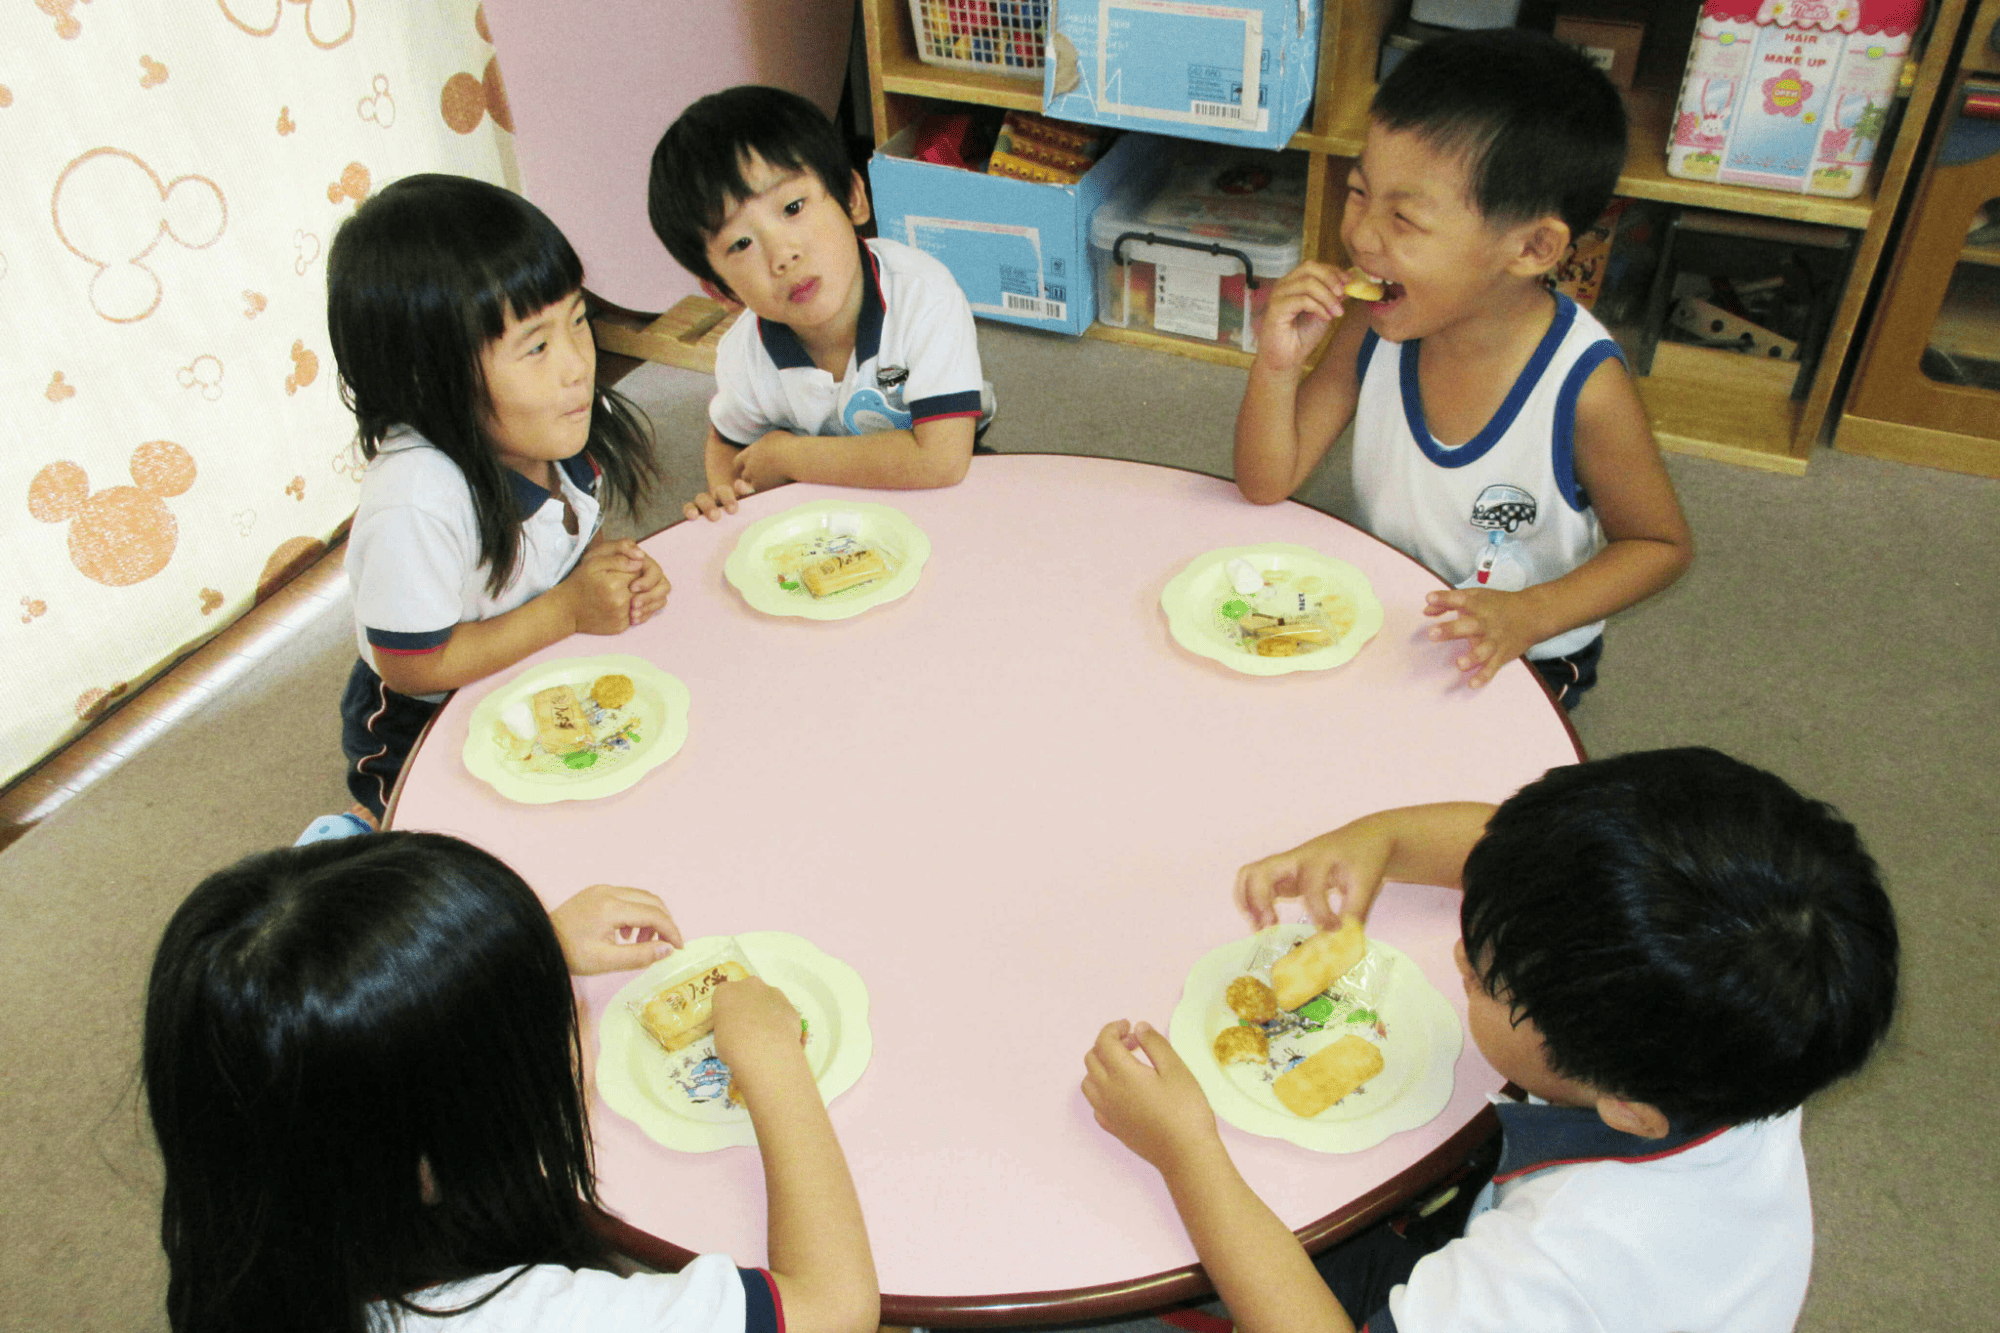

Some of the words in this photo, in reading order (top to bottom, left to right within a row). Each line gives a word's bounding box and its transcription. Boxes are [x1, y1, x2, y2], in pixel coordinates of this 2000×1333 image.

[1784, 33, 1818, 44] HAIR
[1763, 53, 1802, 65] MAKE
[1807, 58, 1826, 67] UP
[1774, 88, 1799, 97] OPEN
